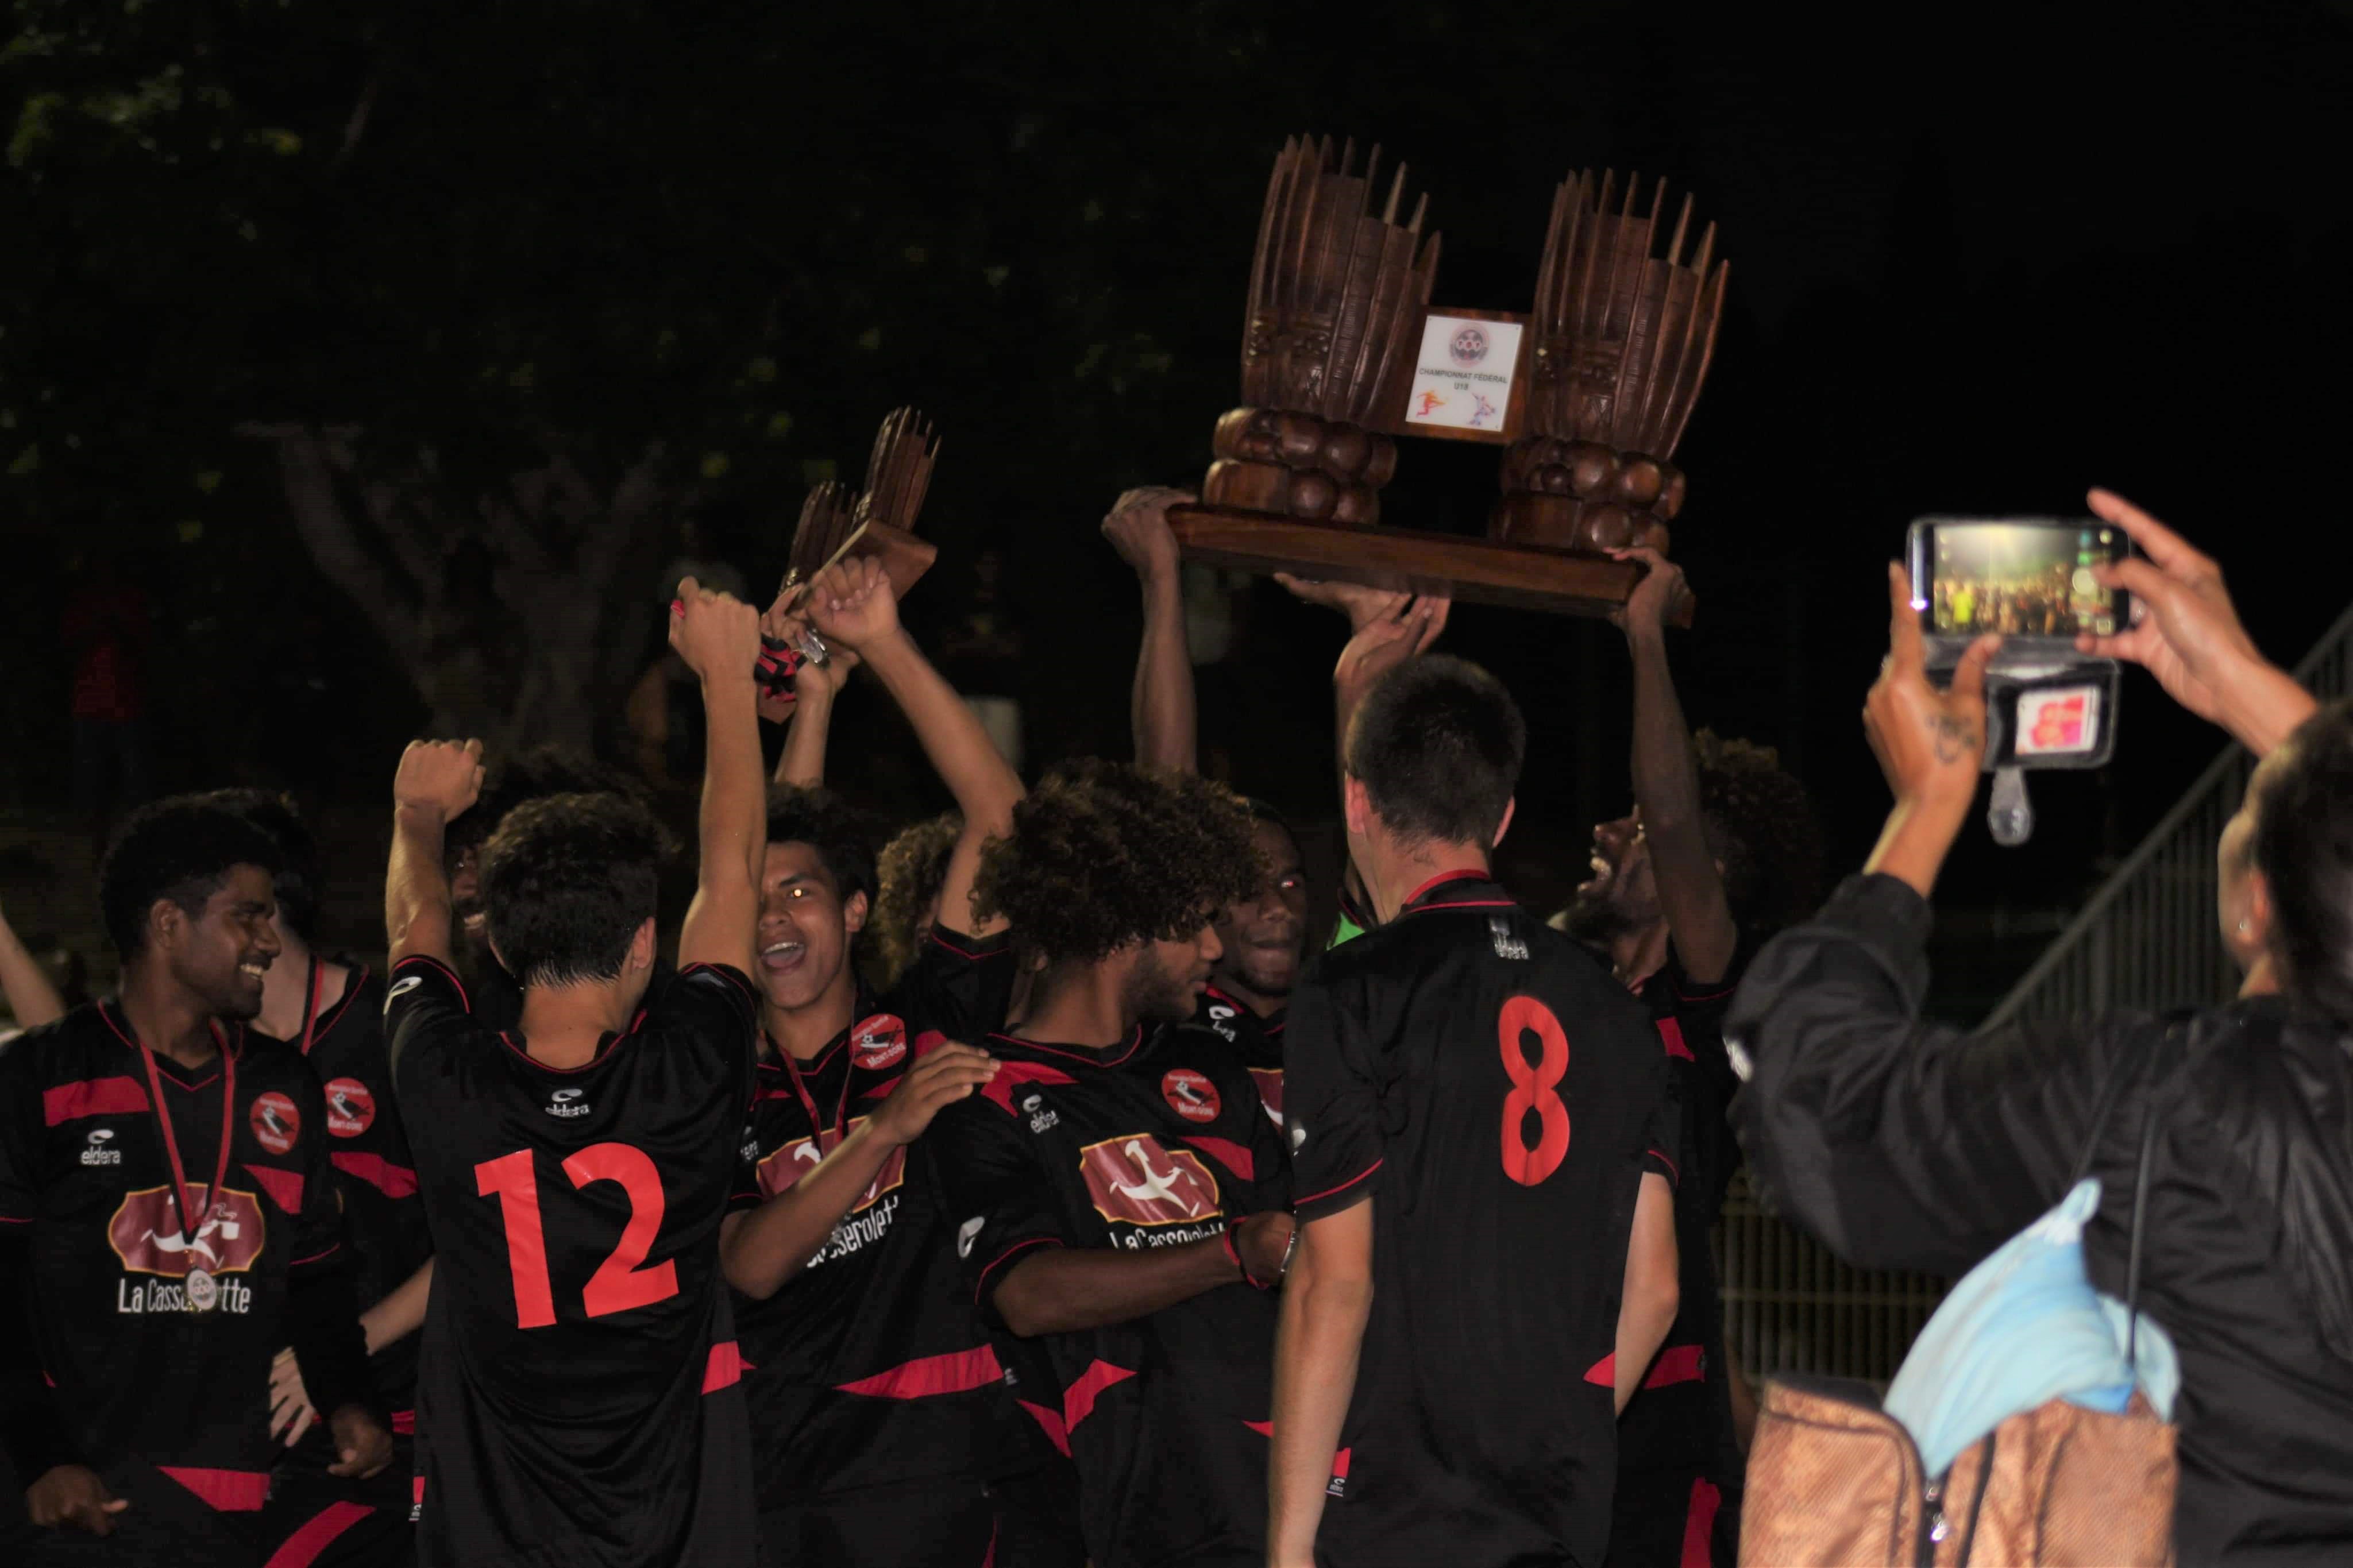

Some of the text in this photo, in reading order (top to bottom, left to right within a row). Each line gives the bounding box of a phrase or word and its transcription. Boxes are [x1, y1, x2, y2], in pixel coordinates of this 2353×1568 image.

[1419, 368, 1472, 380] CHAMPIONNAT
[1498, 995, 1571, 1187] 8
[81, 1145, 121, 1165] eldera
[474, 1141, 680, 1330] 12
[118, 1278, 144, 1313] La
